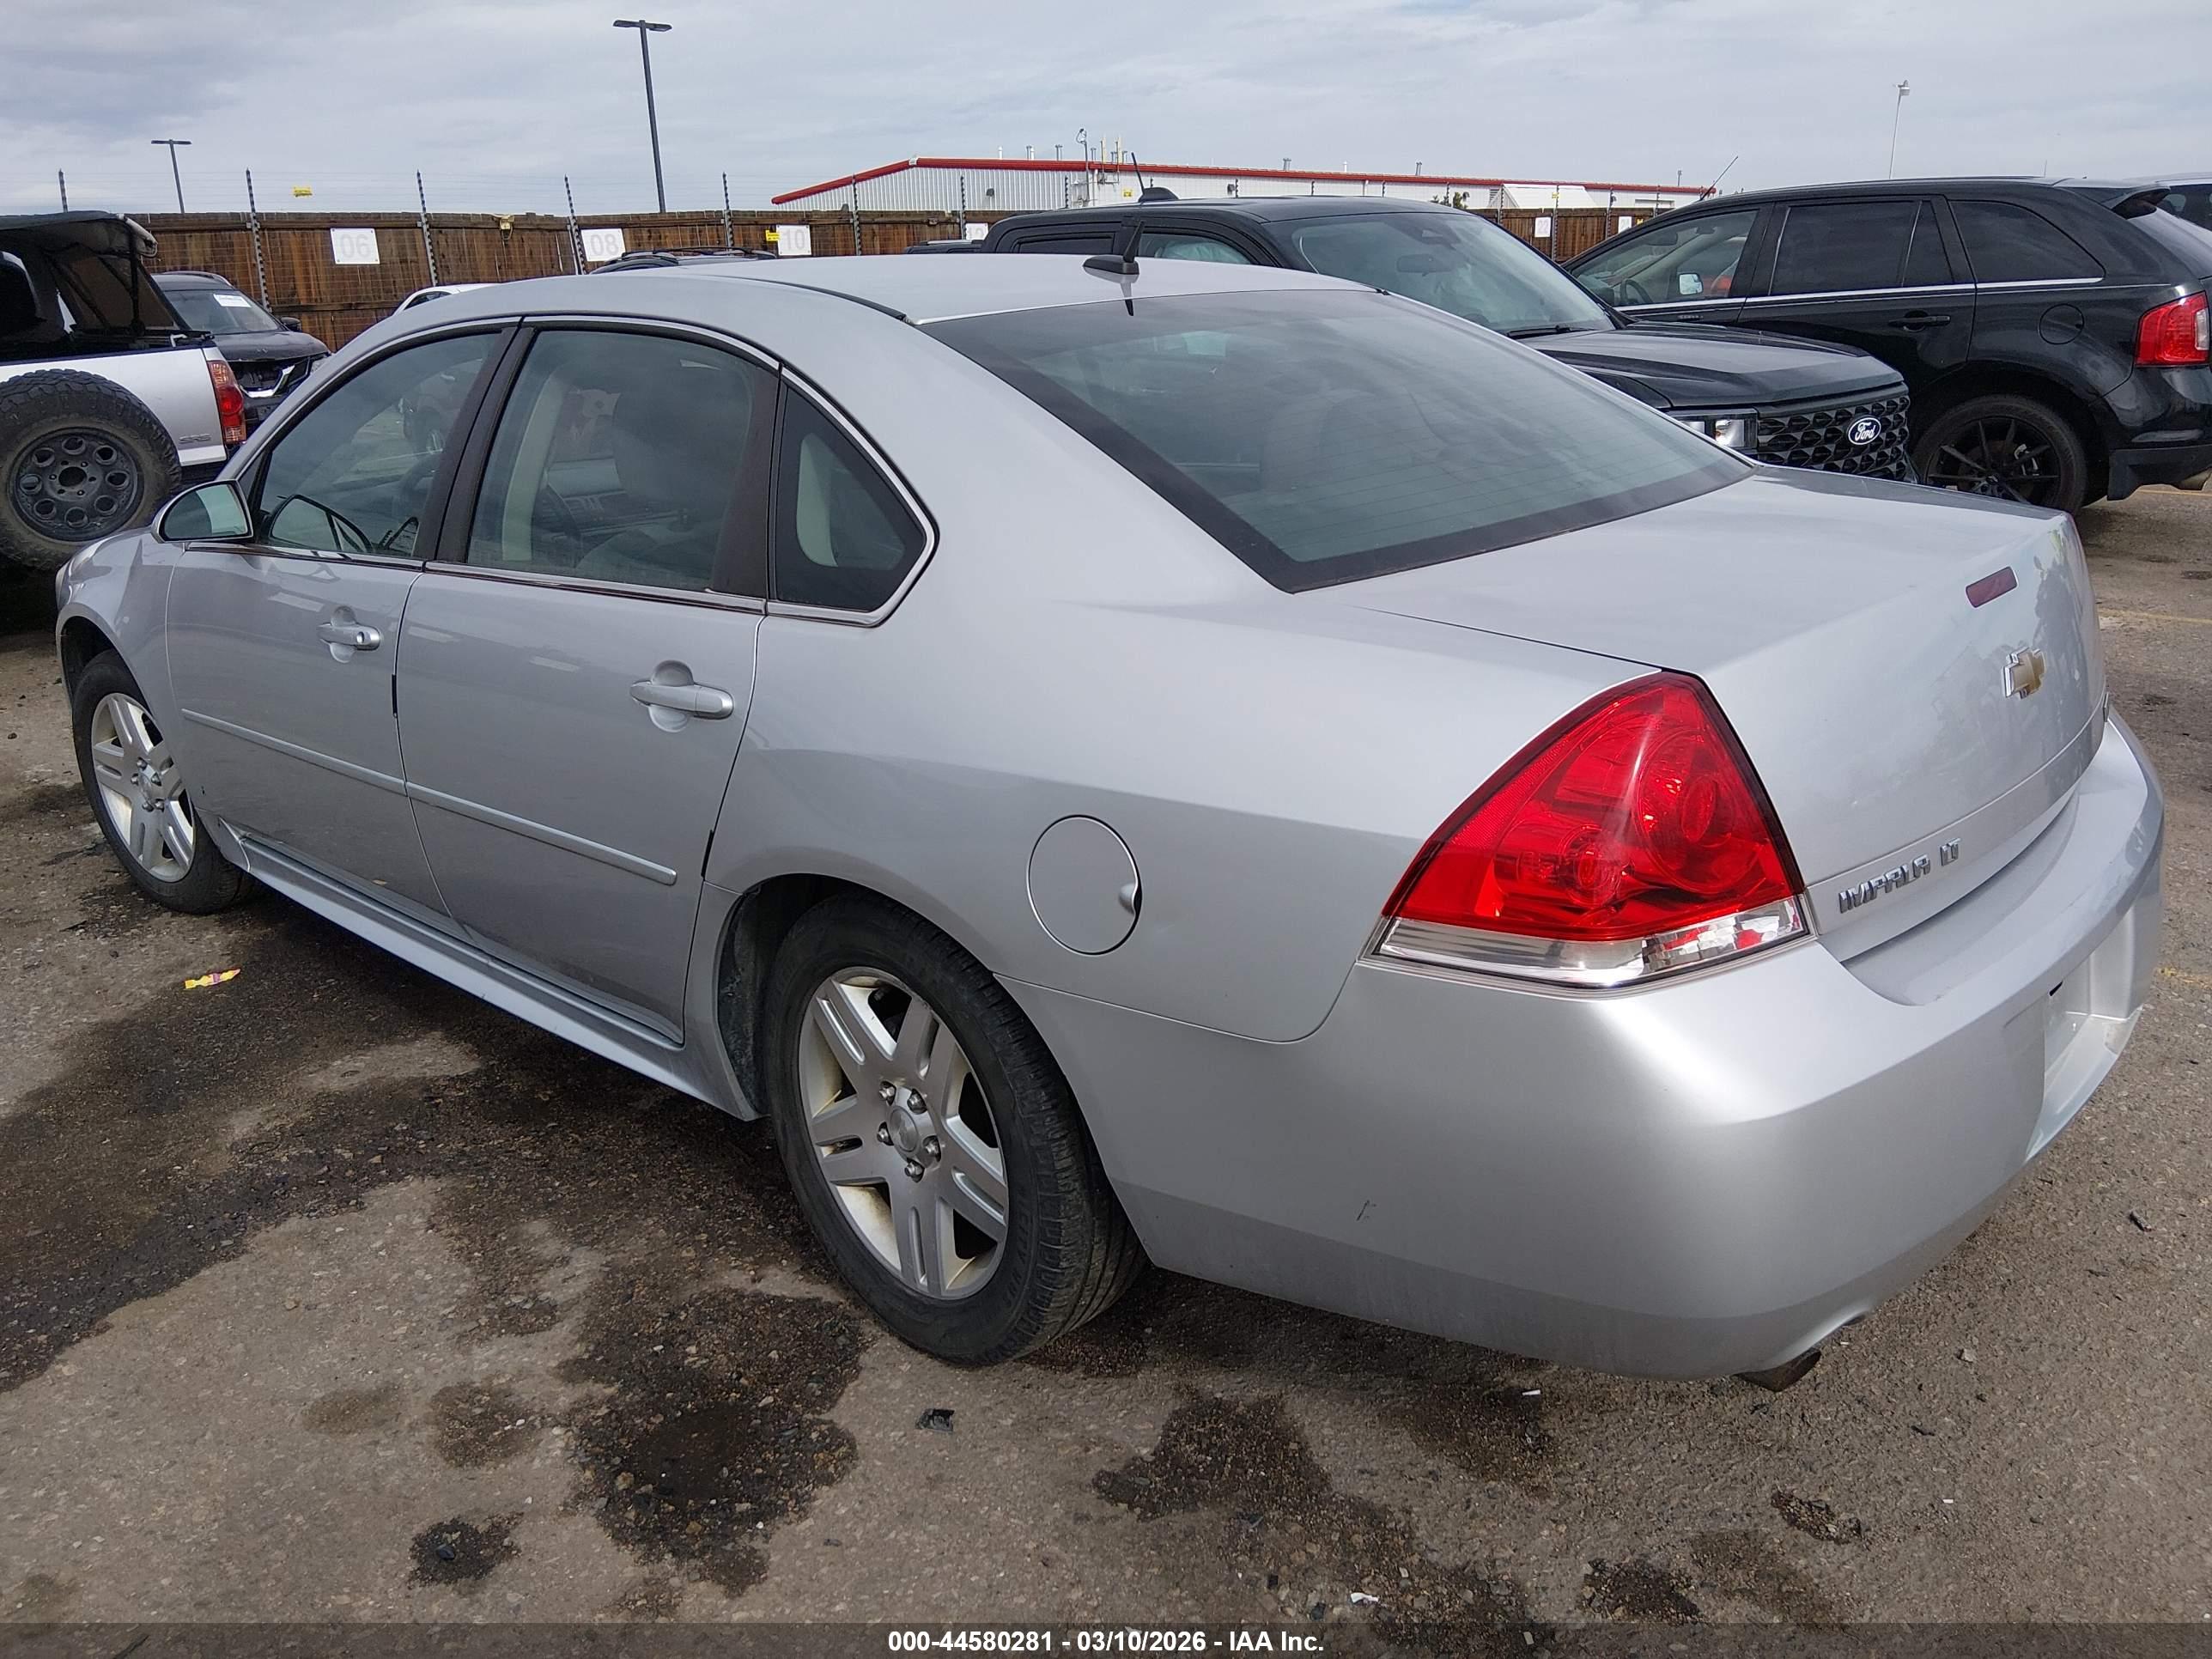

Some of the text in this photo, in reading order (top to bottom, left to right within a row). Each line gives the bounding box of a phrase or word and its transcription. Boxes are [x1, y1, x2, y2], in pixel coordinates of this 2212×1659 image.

[340, 233, 372, 258] 06
[590, 233, 619, 256] 08
[782, 229, 805, 250] 10
[1855, 422, 1876, 441] Ford
[1838, 837, 1961, 914] IMPALA LT
